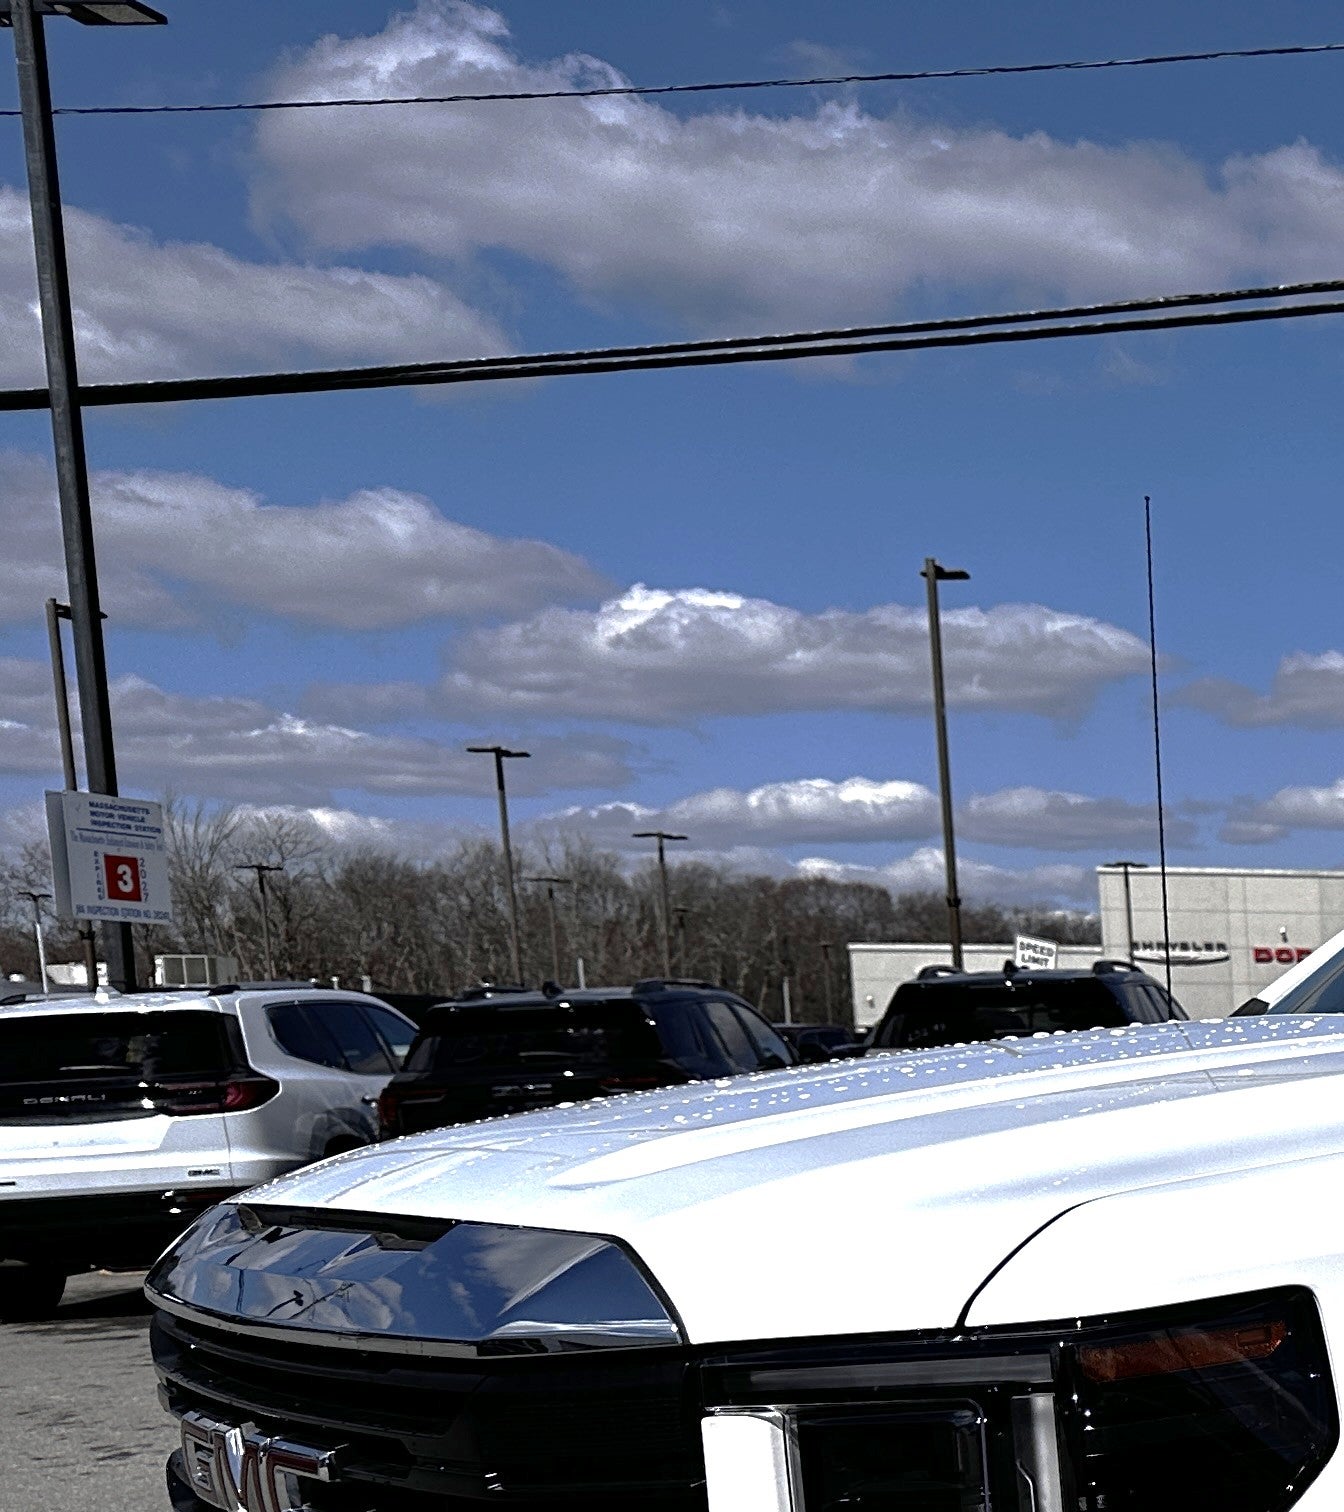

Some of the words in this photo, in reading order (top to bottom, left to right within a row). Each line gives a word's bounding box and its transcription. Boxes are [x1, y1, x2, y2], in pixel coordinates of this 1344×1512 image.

[89, 810, 115, 820] MOTOR
[90, 819, 132, 831] INSPECTION
[134, 825, 161, 834] STATION
[117, 864, 135, 893] 3
[139, 857, 149, 901] 2027
[1019, 941, 1055, 957] SPEED
[1021, 953, 1050, 966] LIMIT
[23, 1094, 106, 1105] DENALI
[187, 1169, 221, 1177] GMC
